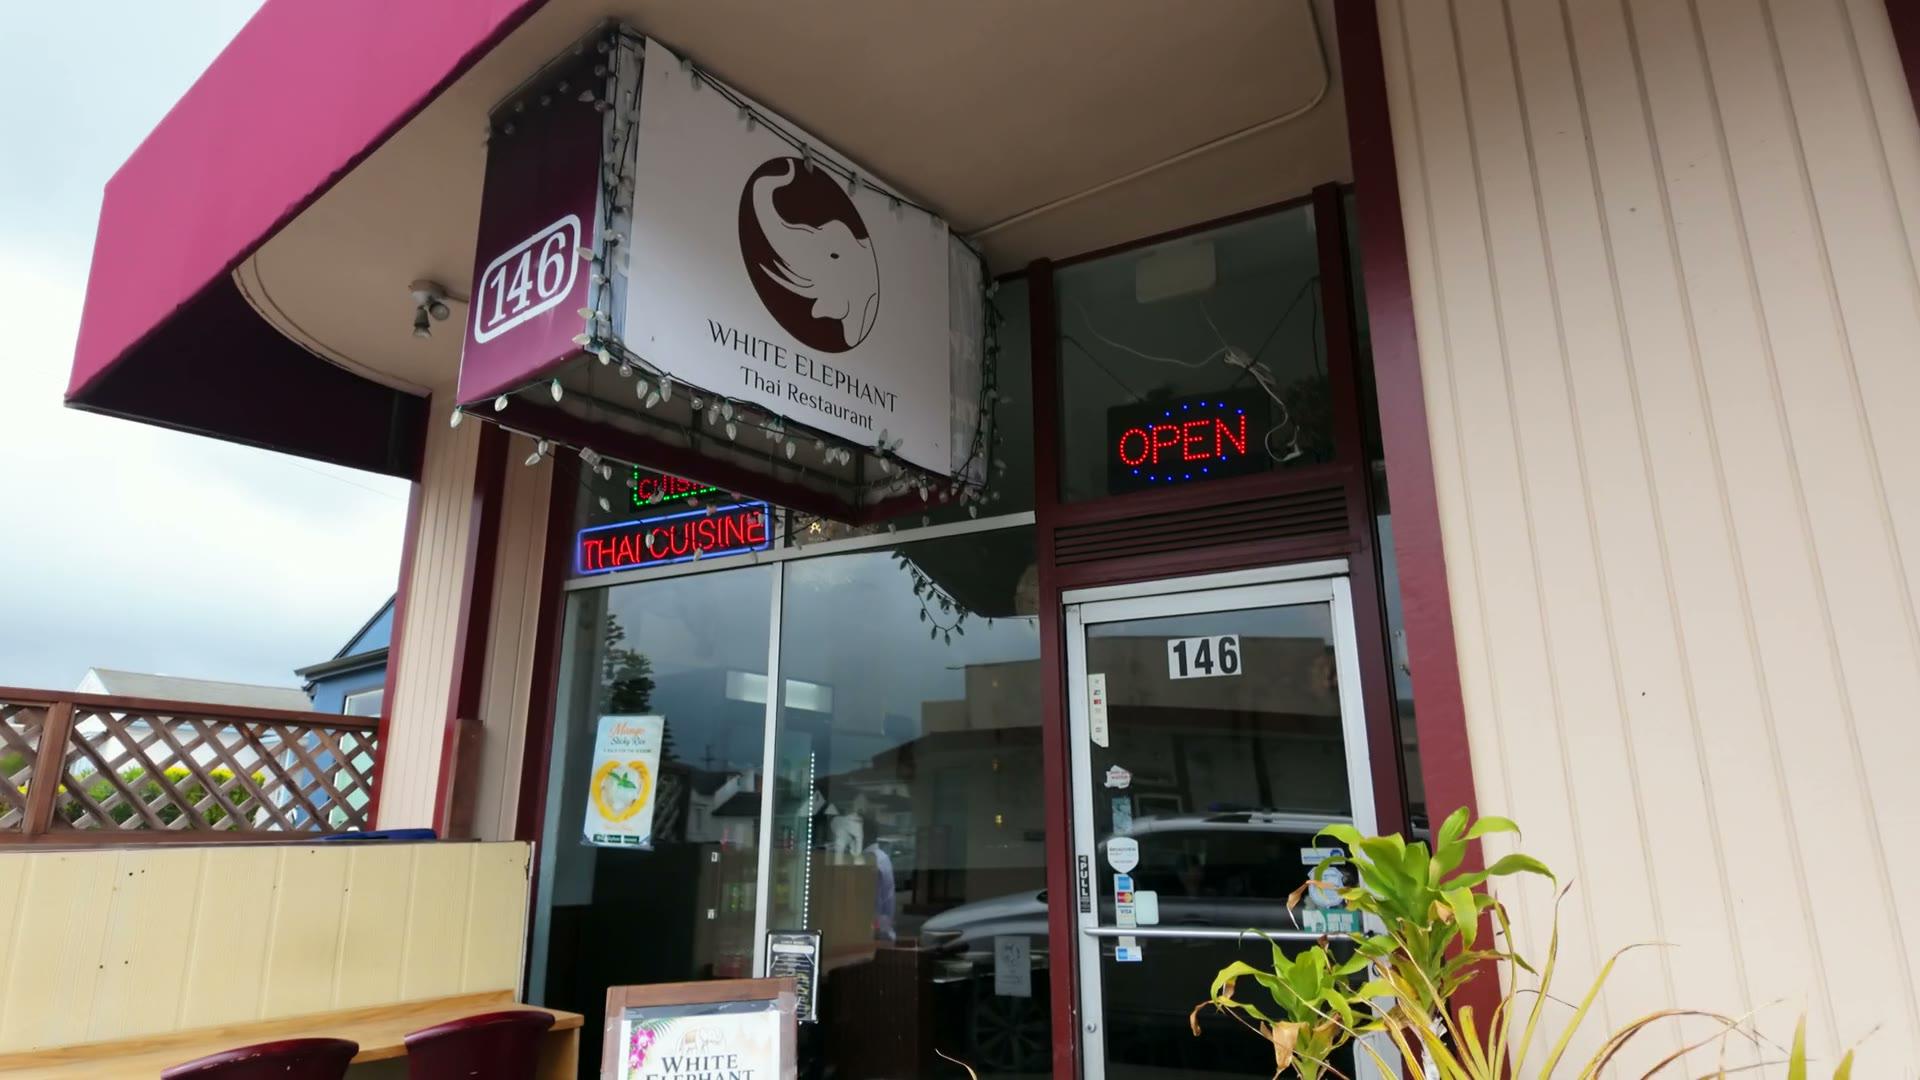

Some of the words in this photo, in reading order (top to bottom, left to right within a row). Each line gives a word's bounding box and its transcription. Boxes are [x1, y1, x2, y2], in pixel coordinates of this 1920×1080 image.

[487, 231, 566, 327] 146
[707, 319, 788, 369] WHITE
[795, 353, 898, 413] ELEPHANT
[740, 365, 781, 397] Thai
[788, 383, 874, 430] Restaurant
[1119, 414, 1246, 466] OPEN
[583, 533, 641, 570] THAI
[650, 510, 765, 559] CUISINE
[1173, 637, 1239, 677] 146
[1080, 862, 1089, 896] PULL
[646, 1069, 754, 1080] HANT
[661, 1054, 738, 1073] WHITE
